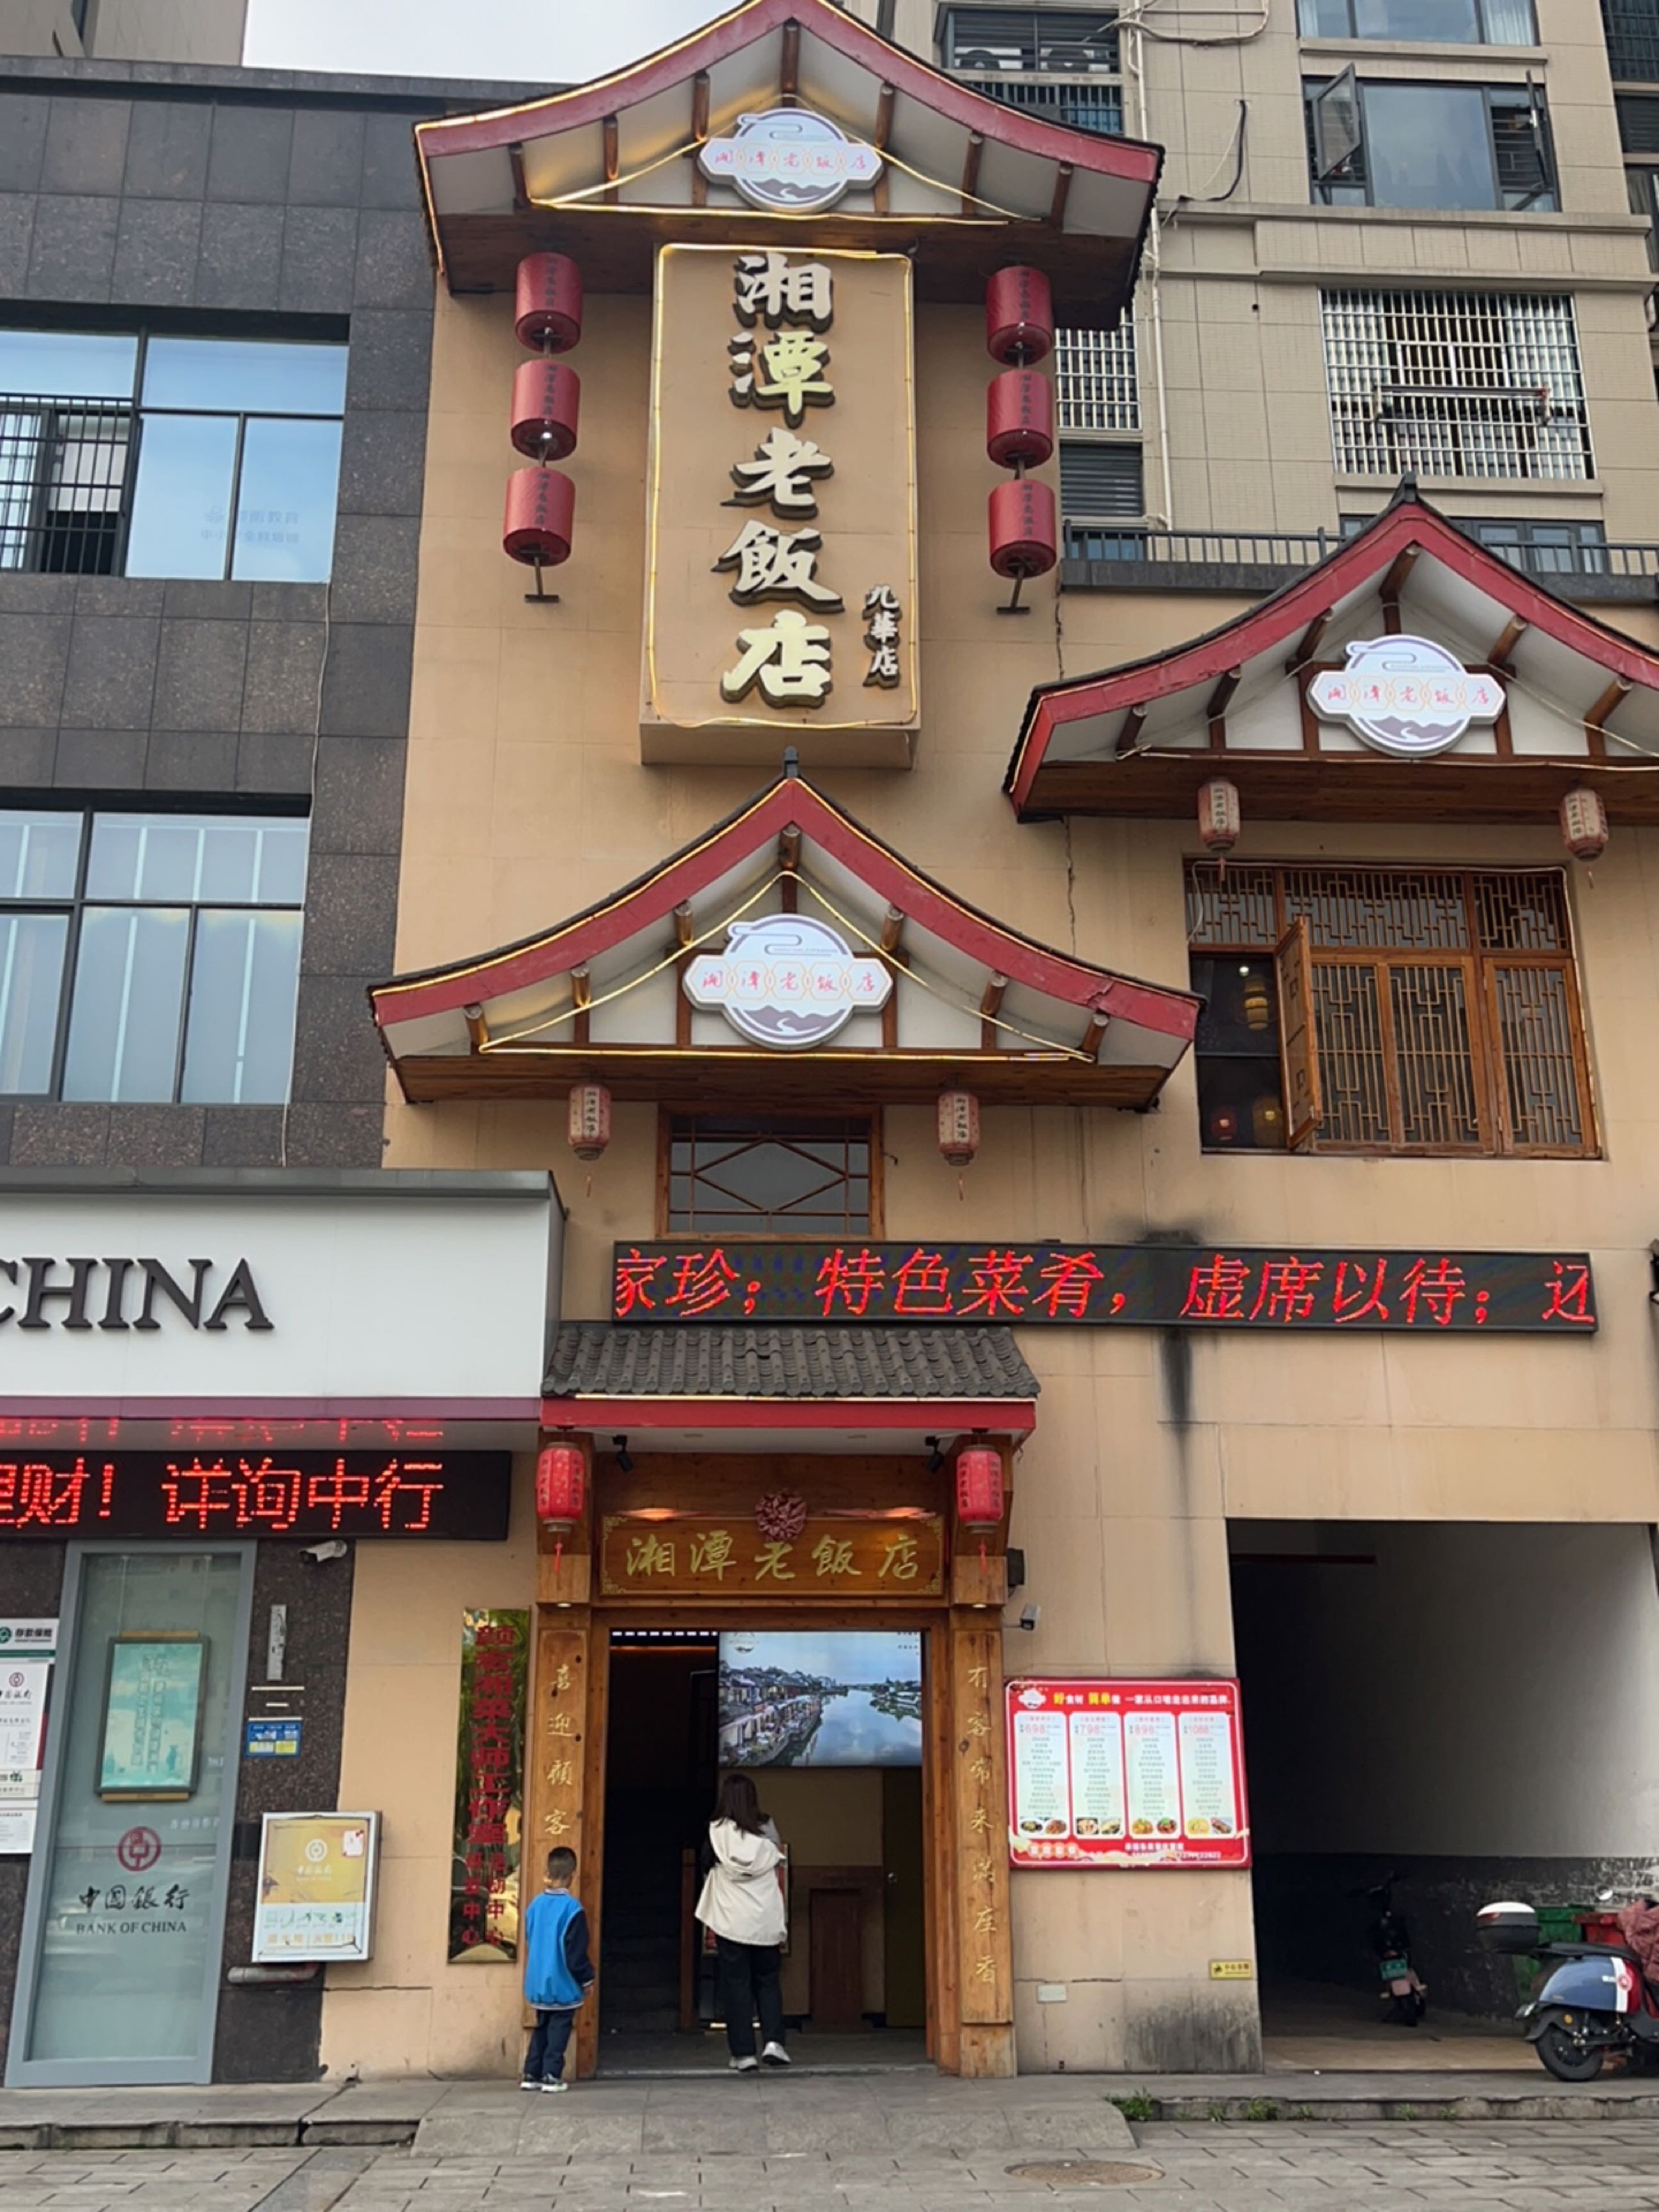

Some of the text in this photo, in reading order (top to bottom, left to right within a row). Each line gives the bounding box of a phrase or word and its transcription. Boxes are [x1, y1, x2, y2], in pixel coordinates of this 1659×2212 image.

[76, 1921, 187, 1935] BANK OF CHINA
